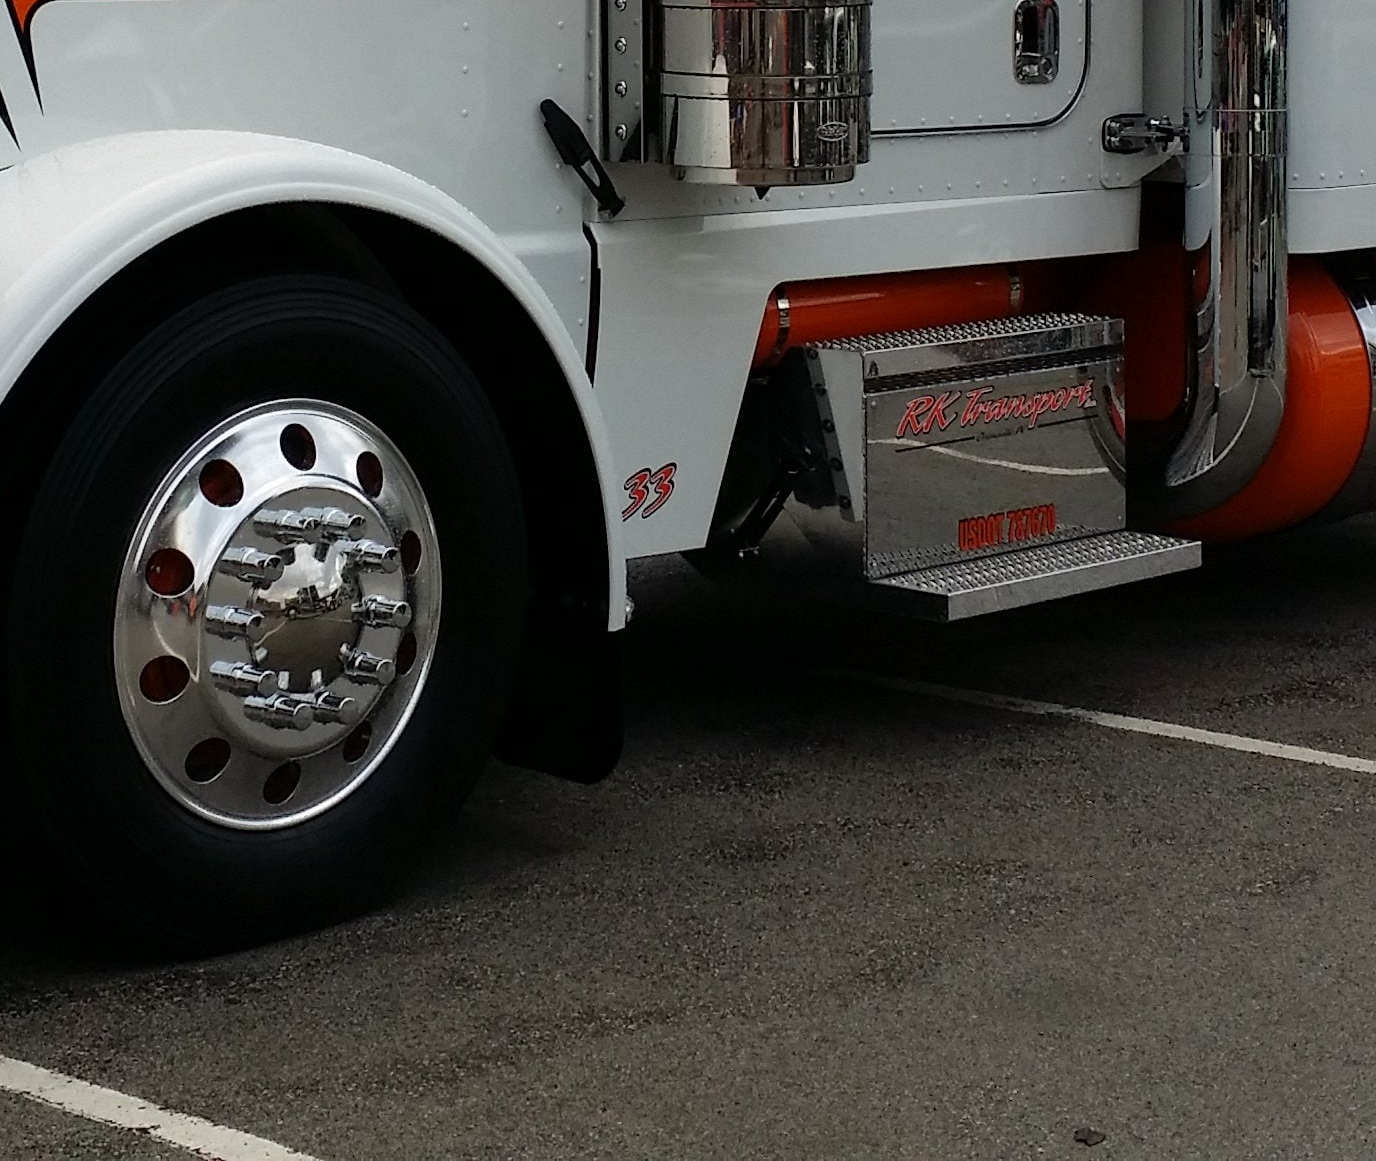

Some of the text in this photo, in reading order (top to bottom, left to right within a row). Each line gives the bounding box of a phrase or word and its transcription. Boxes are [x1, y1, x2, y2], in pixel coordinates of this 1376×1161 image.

[895, 390, 962, 439] RK
[960, 377, 1096, 429] Transport
[621, 461, 678, 522] 33
[958, 513, 1005, 552] USDOT
